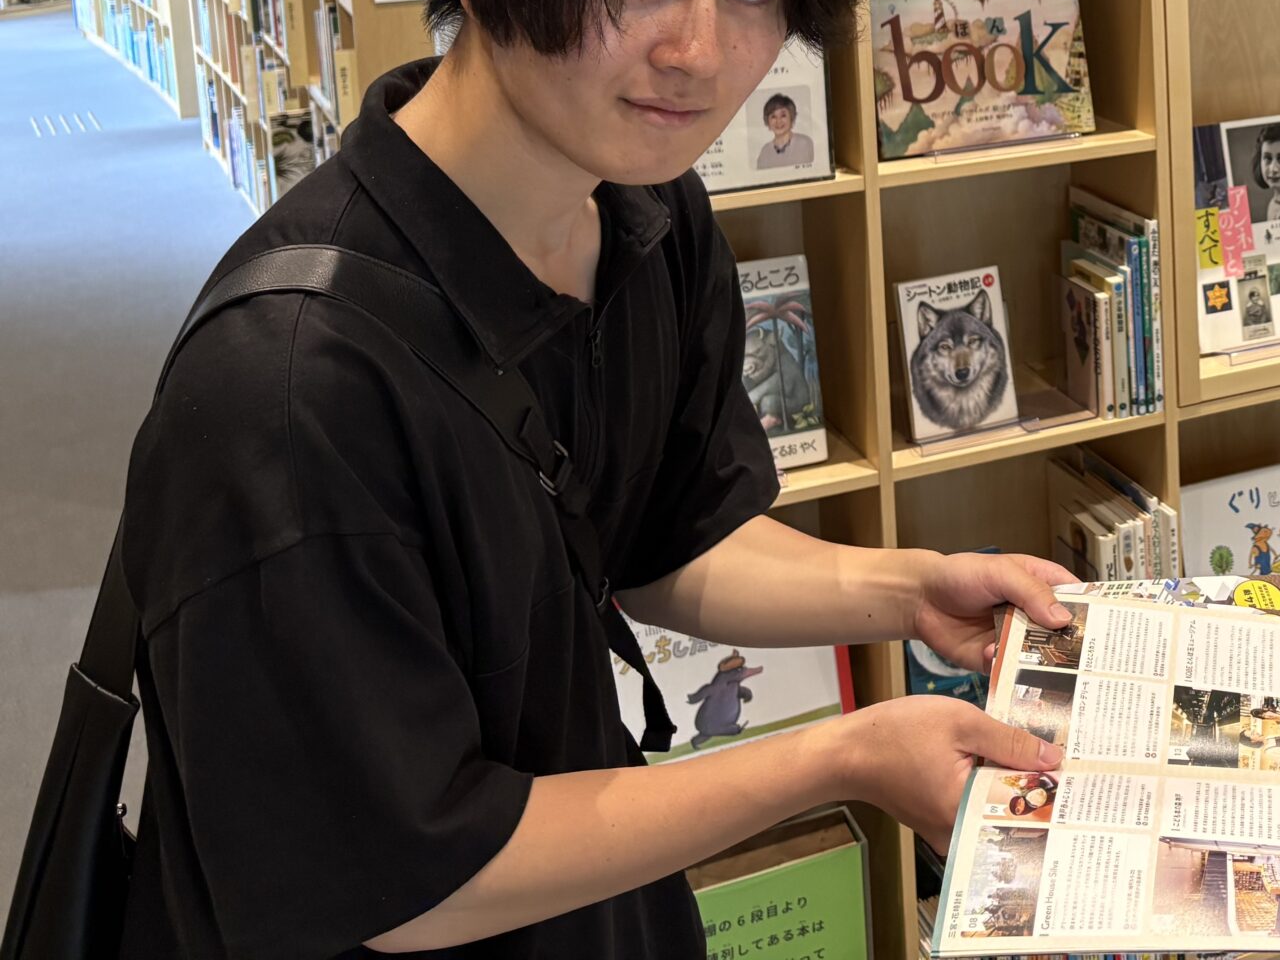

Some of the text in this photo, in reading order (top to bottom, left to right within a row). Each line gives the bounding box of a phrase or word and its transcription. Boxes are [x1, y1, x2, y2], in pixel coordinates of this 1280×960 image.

[880, 9, 1081, 104] book
[954, 19, 1005, 39] ほん
[1197, 209, 1219, 265] すべて
[1219, 214, 1240, 273] のこと
[1233, 189, 1251, 250] アンネ
[740, 266, 800, 293] るところ
[906, 276, 982, 302] シートン動物記
[1040, 860, 1059, 930] Green House Silva
